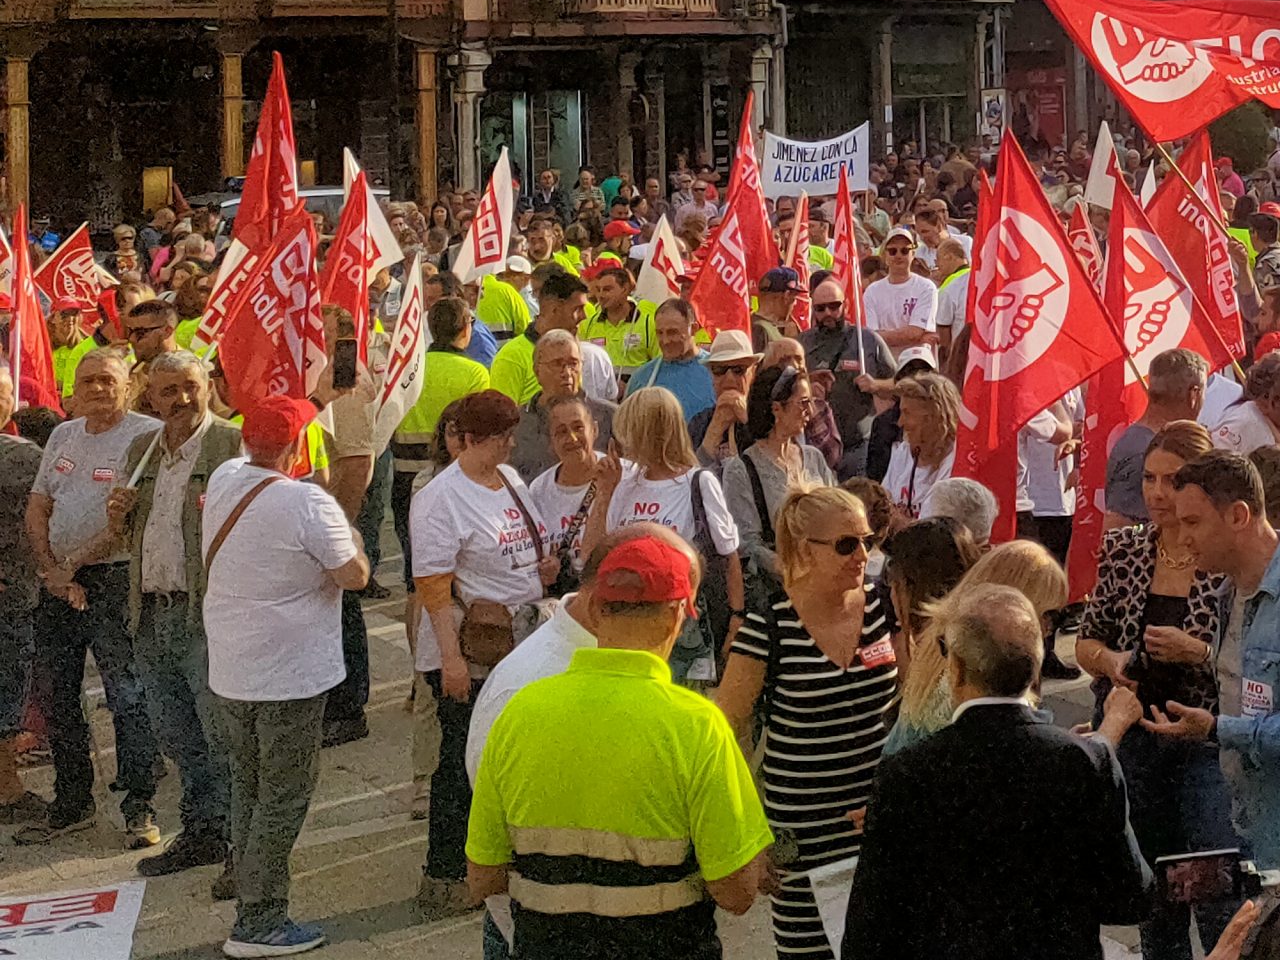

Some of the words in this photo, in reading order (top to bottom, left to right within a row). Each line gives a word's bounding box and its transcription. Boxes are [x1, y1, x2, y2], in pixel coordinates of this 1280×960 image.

[772, 142, 817, 163] JIMENEZ
[634, 502, 660, 515] NO
[1246, 681, 1264, 694] NO
